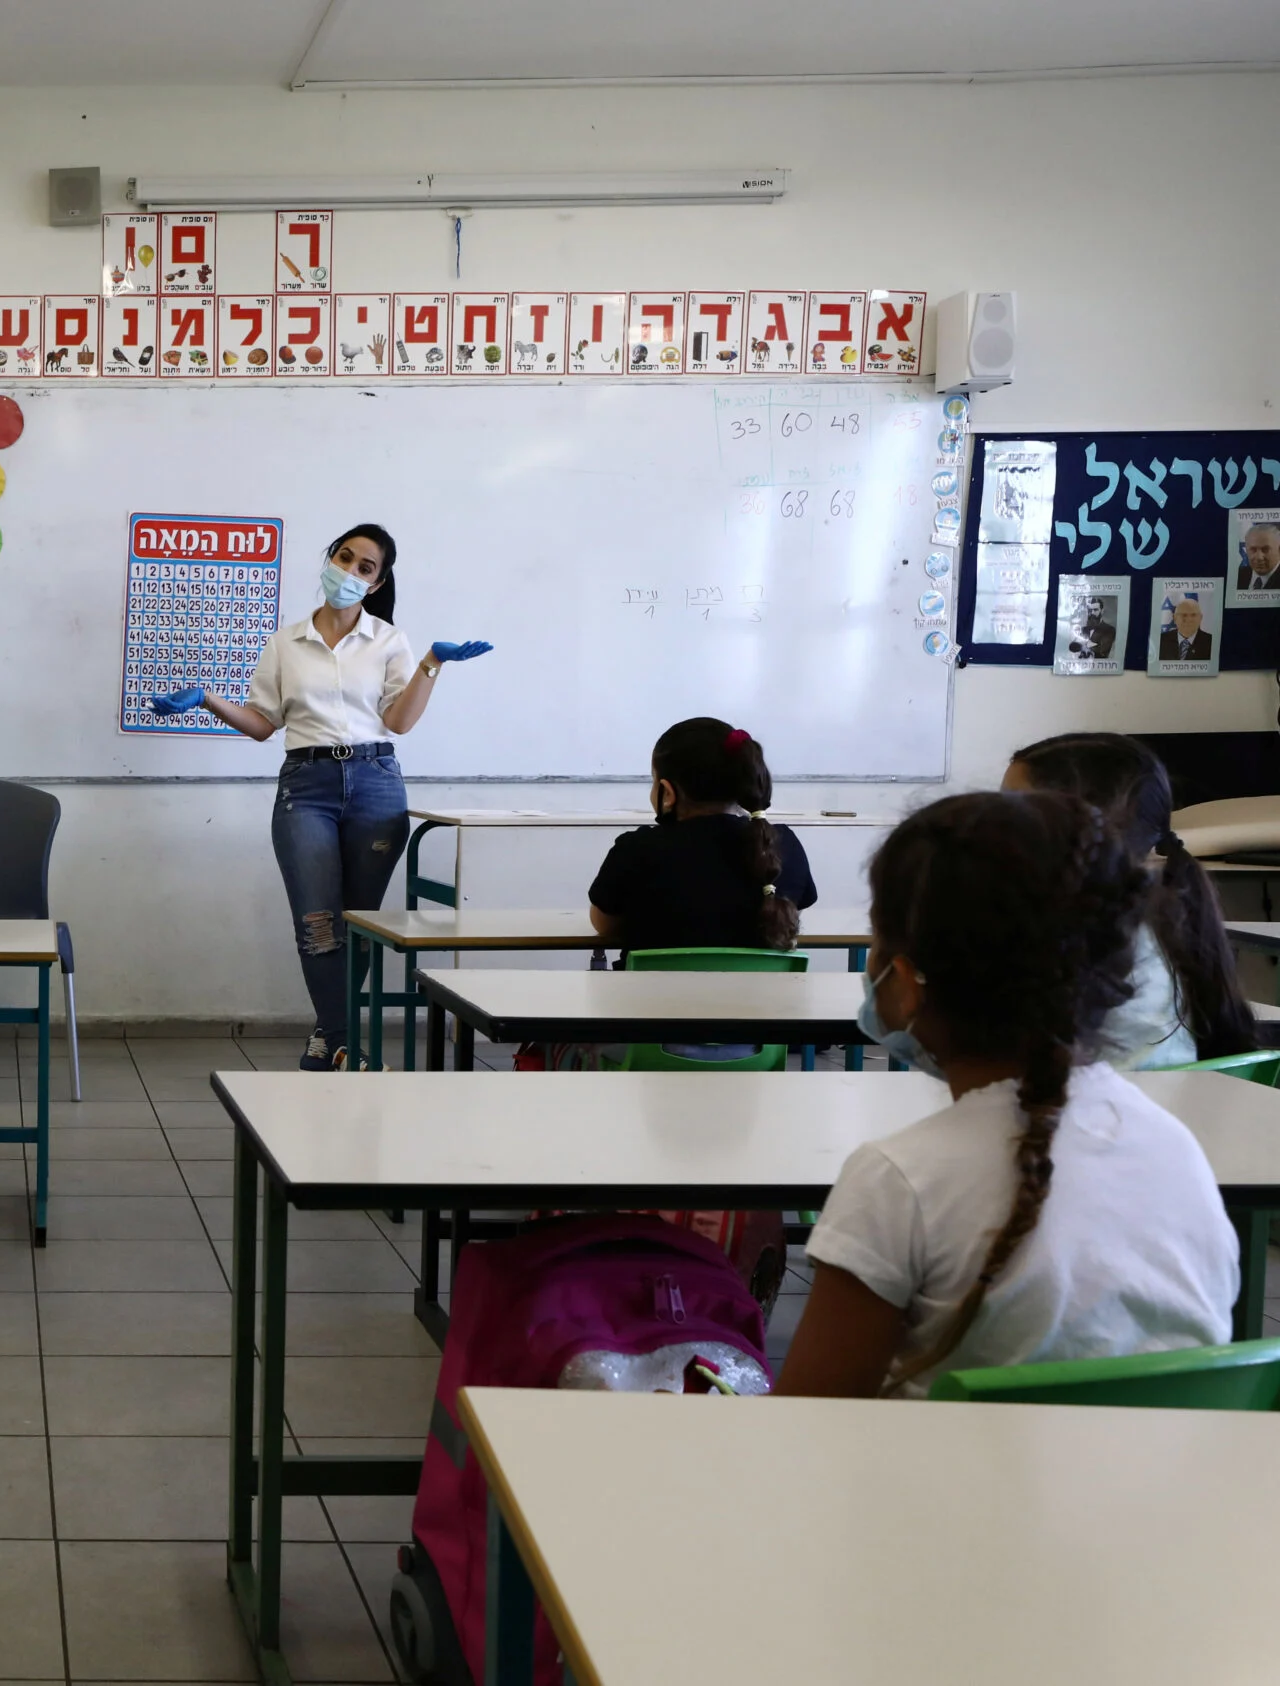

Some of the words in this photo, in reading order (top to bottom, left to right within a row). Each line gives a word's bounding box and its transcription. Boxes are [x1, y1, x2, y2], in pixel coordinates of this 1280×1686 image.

[172, 226, 205, 263] ם
[289, 224, 320, 267] ך
[56, 309, 88, 345] ס
[123, 309, 138, 345] נ
[171, 309, 204, 346] מ
[230, 304, 262, 346] ל
[288, 307, 320, 344] כ
[358, 307, 367, 323] י
[405, 306, 438, 343] ט
[464, 306, 496, 342] ח
[530, 305, 549, 342] ז
[592, 305, 603, 342] ו
[641, 305, 673, 342] ה
[700, 304, 732, 341] ד
[764, 303, 788, 340] ג
[818, 304, 852, 341] ב
[877, 303, 913, 341] א
[731, 418, 761, 439] 33
[781, 412, 812, 438] 60
[830, 413, 860, 435] 48
[1084, 441, 1280, 511] ישראל
[780, 490, 808, 518] 68
[830, 489, 856, 519] 68
[1054, 502, 1170, 570] שלי
[132, 582, 142, 592] 11
[147, 582, 157, 593] 12
[161, 583, 172, 594] 13
[176, 584, 186, 594] 14
[191, 584, 201, 595] 15
[206, 585, 216, 595] 16
[220, 585, 231, 596] 17
[235, 586, 245, 596] 18
[250, 586, 260, 597] 19
[264, 587, 275, 597] 20
[136, 566, 140, 576] 1
[150, 566, 156, 576] 2
[164, 566, 171, 577] 3
[179, 567, 186, 577] 4
[194, 568, 200, 578] 5
[208, 568, 215, 579] 6
[224, 568, 230, 579] 7
[238, 569, 244, 580] 8
[253, 570, 259, 580] 9
[265, 570, 276, 581] 10
[131, 598, 142, 609] 21
[145, 598, 157, 609] 22
[160, 599, 172, 610] 23
[175, 600, 187, 610] 24
[189, 600, 201, 611] 25
[204, 601, 216, 612] 26
[218, 601, 230, 612] 27
[234, 602, 246, 613] 28
[248, 602, 260, 613] 29
[263, 603, 274, 614] 30
